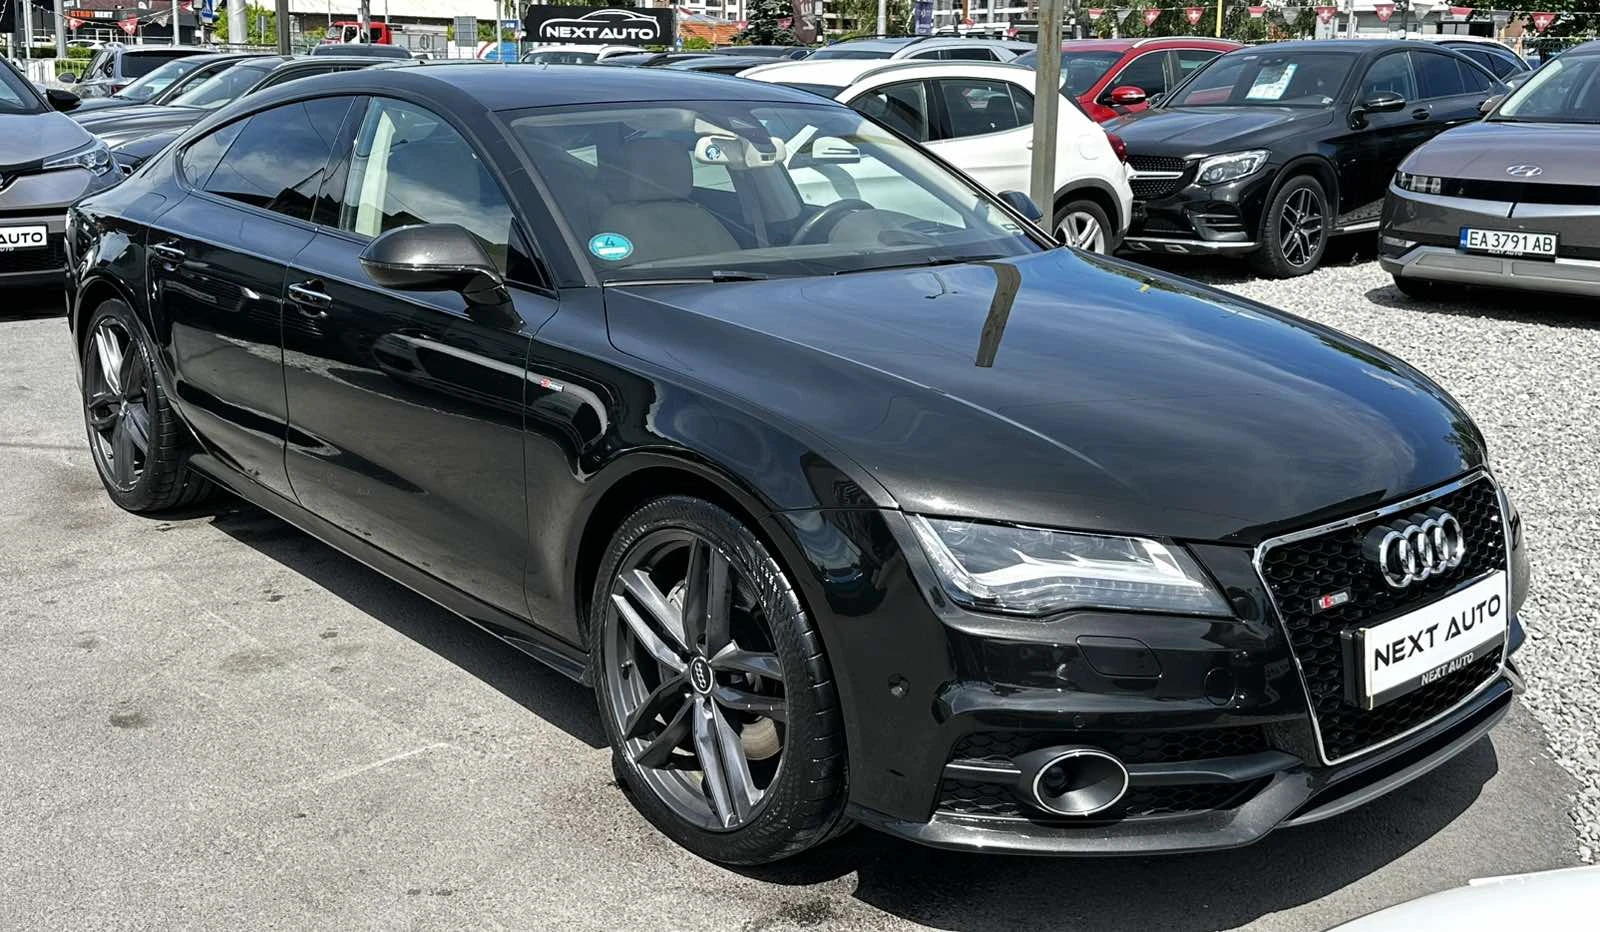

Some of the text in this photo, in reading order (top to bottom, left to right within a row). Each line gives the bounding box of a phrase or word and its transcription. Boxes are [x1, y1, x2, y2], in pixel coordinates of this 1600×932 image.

[545, 26, 654, 40] NEXT AUTO
[1469, 231, 1553, 252] EA 3791 AB
[1374, 593, 1501, 672] NEXT AUTO
[1421, 652, 1474, 686] NEXT AUTO
